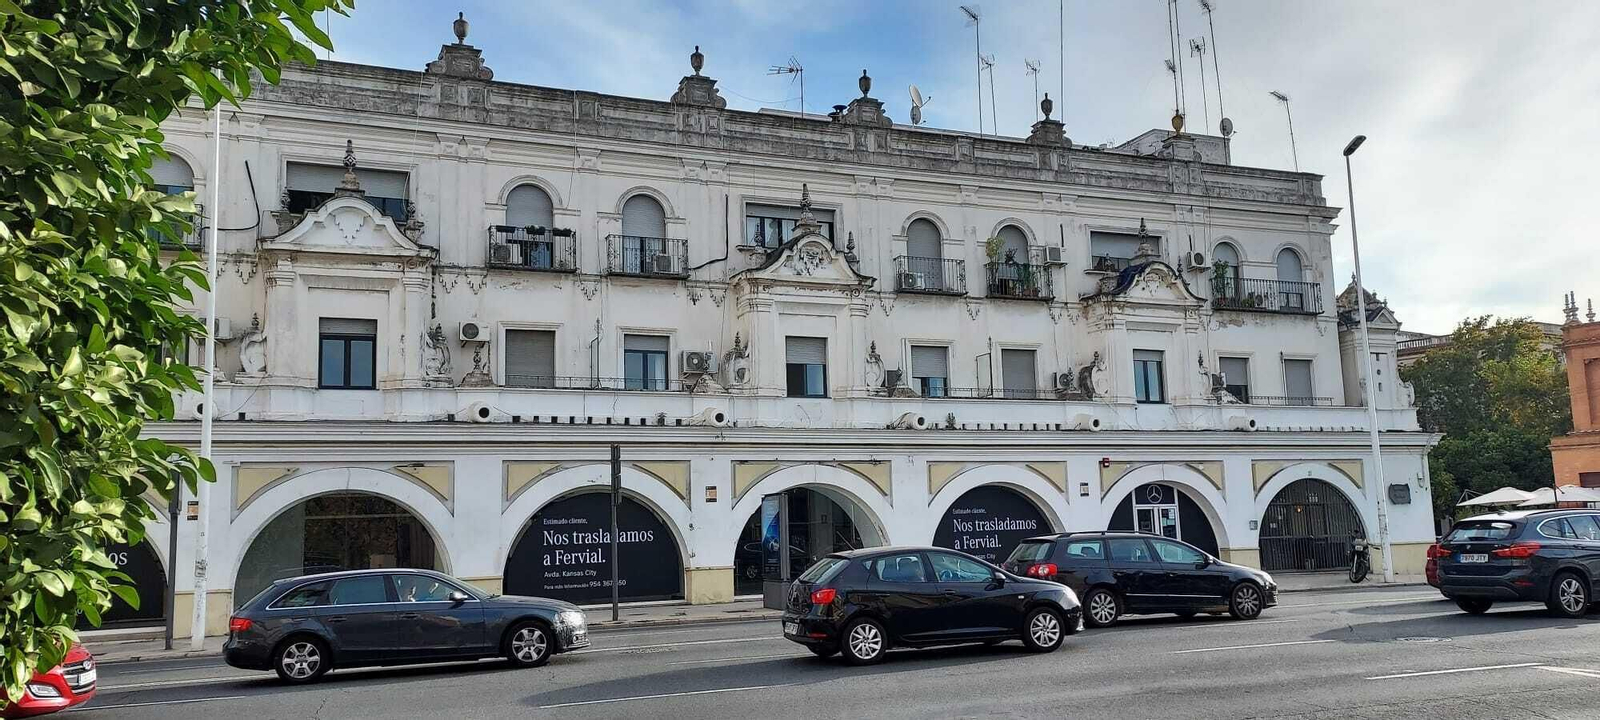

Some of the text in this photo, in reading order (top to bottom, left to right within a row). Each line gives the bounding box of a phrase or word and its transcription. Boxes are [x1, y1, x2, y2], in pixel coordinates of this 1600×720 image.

[953, 517, 1037, 533] Nos trasladamos
[543, 530, 569, 546] Nos
[954, 535, 1002, 550] a Fervial.
[543, 548, 606, 566] a Fervial.
[585, 569, 597, 577] City
